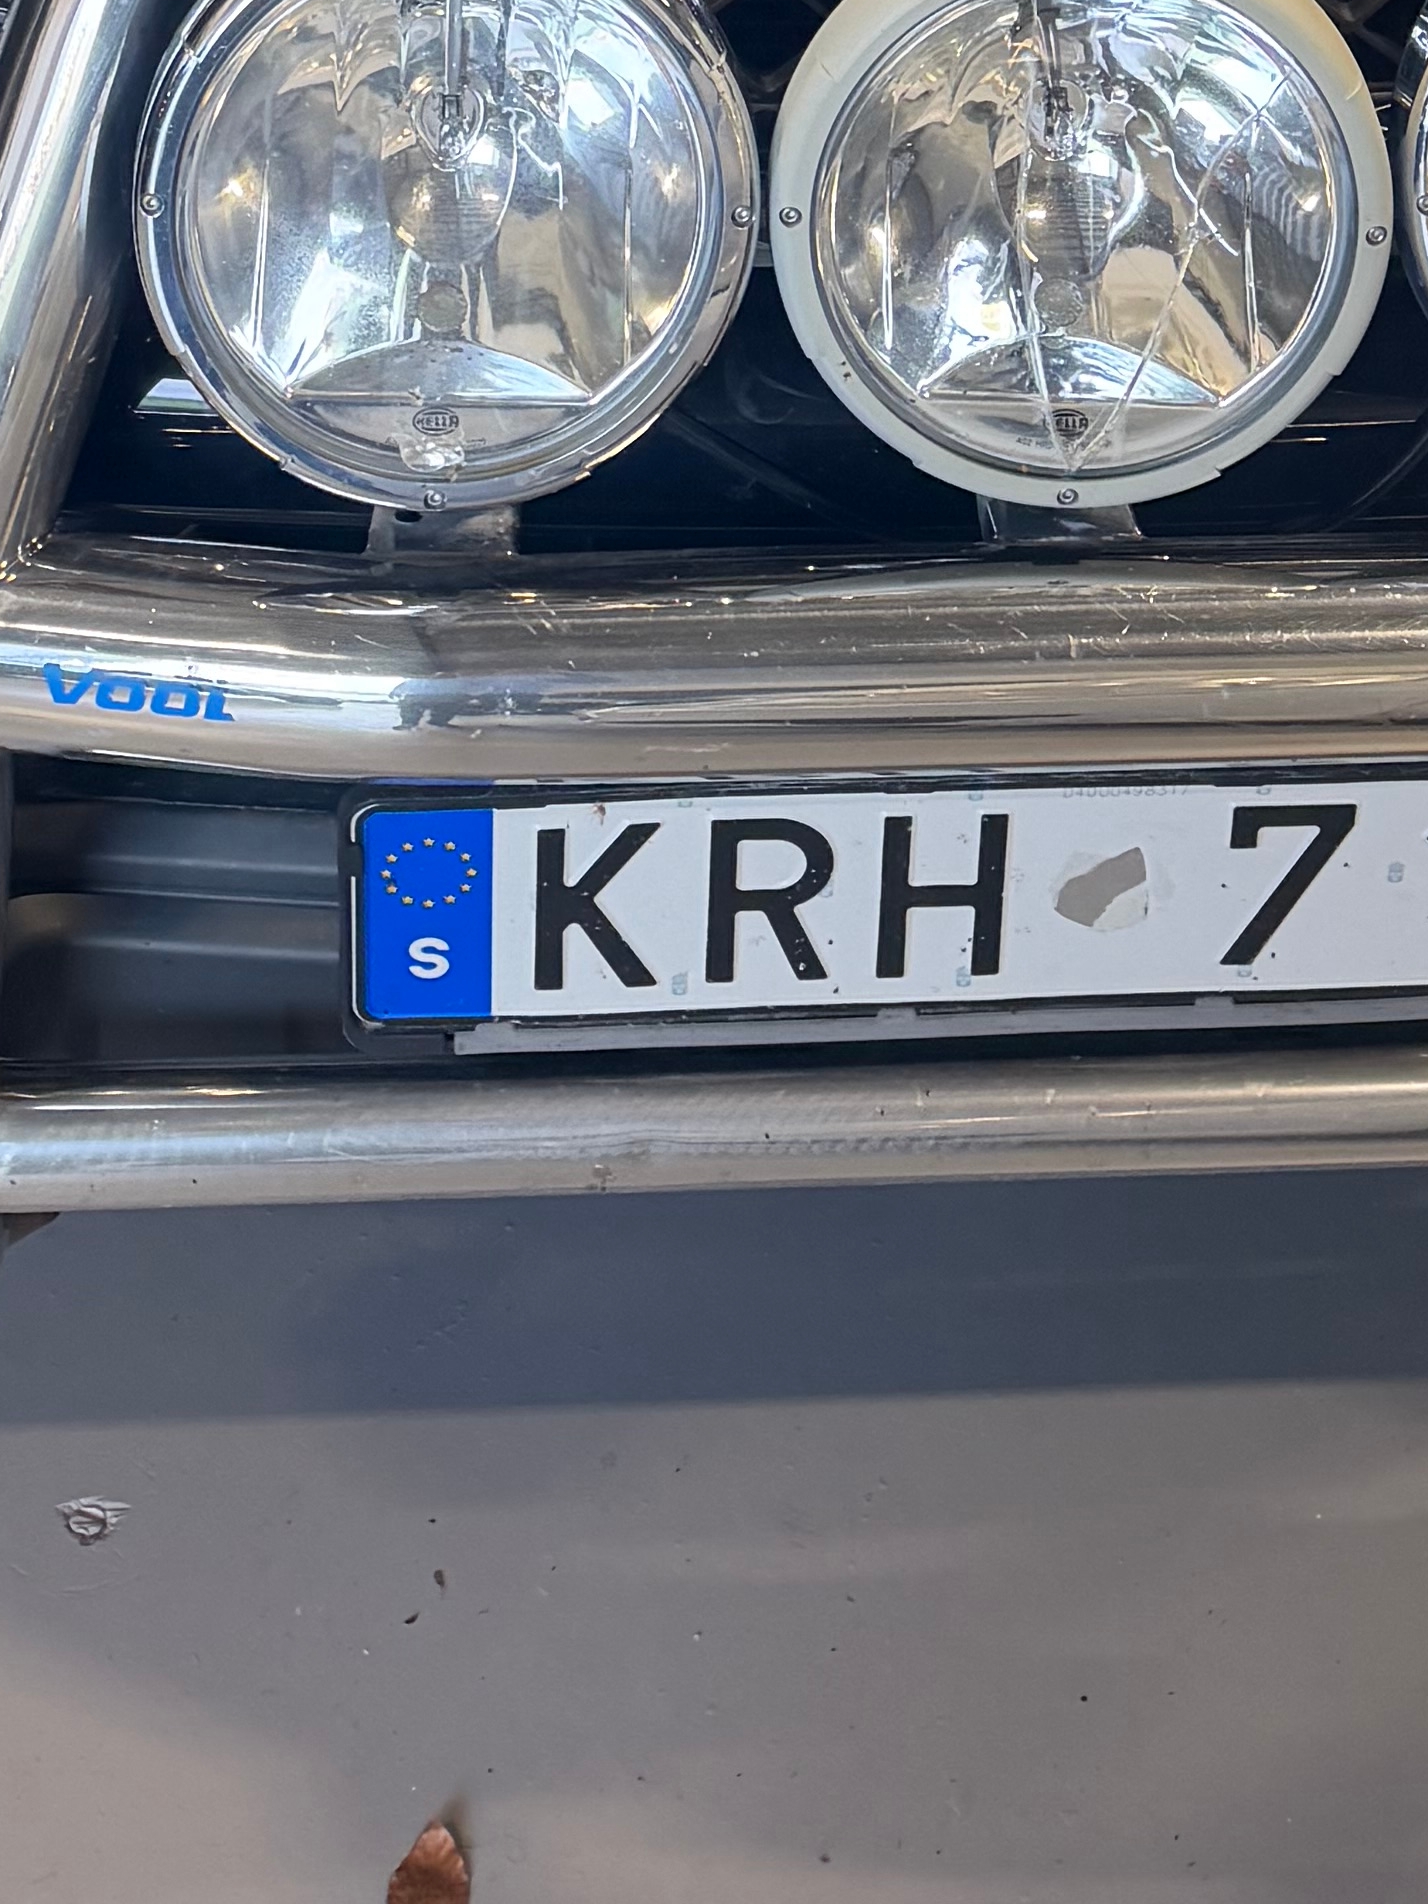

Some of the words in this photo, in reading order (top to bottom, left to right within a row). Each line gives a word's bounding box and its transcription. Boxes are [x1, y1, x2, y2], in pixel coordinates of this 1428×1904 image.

[416, 414, 459, 428] HELLA
[534, 812, 1010, 991] KRH
[408, 936, 451, 980] S
